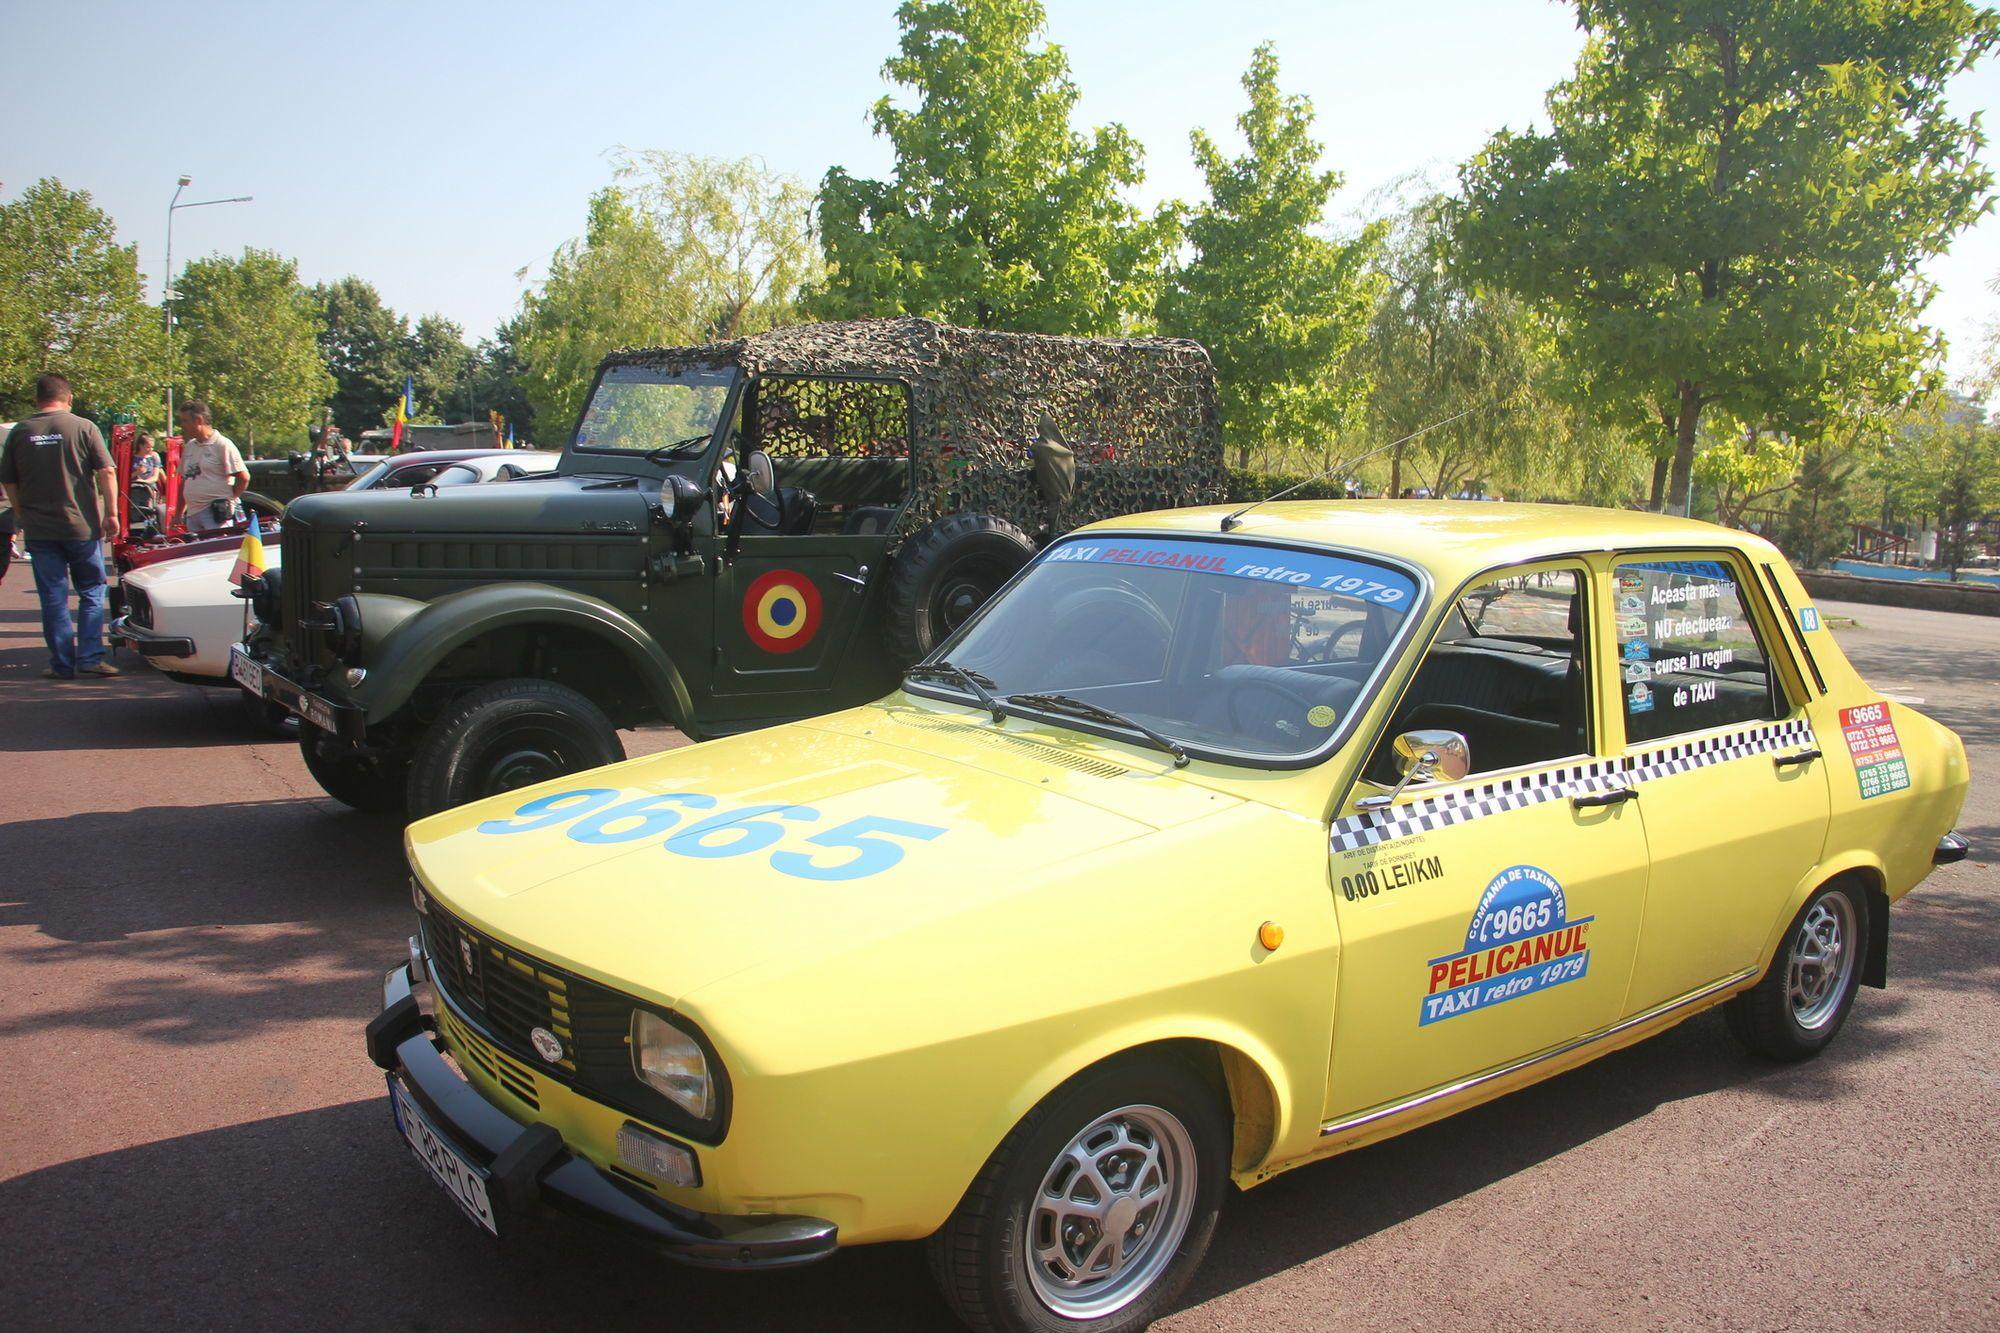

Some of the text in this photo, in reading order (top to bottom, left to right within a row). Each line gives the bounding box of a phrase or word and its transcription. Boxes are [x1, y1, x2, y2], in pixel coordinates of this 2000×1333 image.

[1047, 547, 1405, 605] TAXI PELICANUL retro 1979
[1651, 583, 1696, 605] Aceasta
[1655, 618, 1672, 640] NU
[1655, 654, 1687, 675] curse
[1689, 651, 1700, 669] in
[1702, 646, 1733, 670] regim
[1673, 687, 1687, 707] de
[1690, 681, 1716, 704] TAXI
[1853, 704, 1882, 724] 9665
[1851, 740, 1870, 752] 0722
[1869, 738, 1879, 748] 33
[1865, 728, 1875, 738] 33
[1878, 765, 1887, 774] 33
[1880, 774, 1889, 783] 33
[1881, 783, 1891, 792] 33
[477, 788, 950, 881] 9665
[1341, 855, 1444, 903] 0,00 LEI/KM
[1469, 869, 1565, 939] COMPANIA DE TAXIMETRE
[1493, 898, 1551, 939] 9665
[1427, 956, 1585, 1019] TAXI retro 1979
